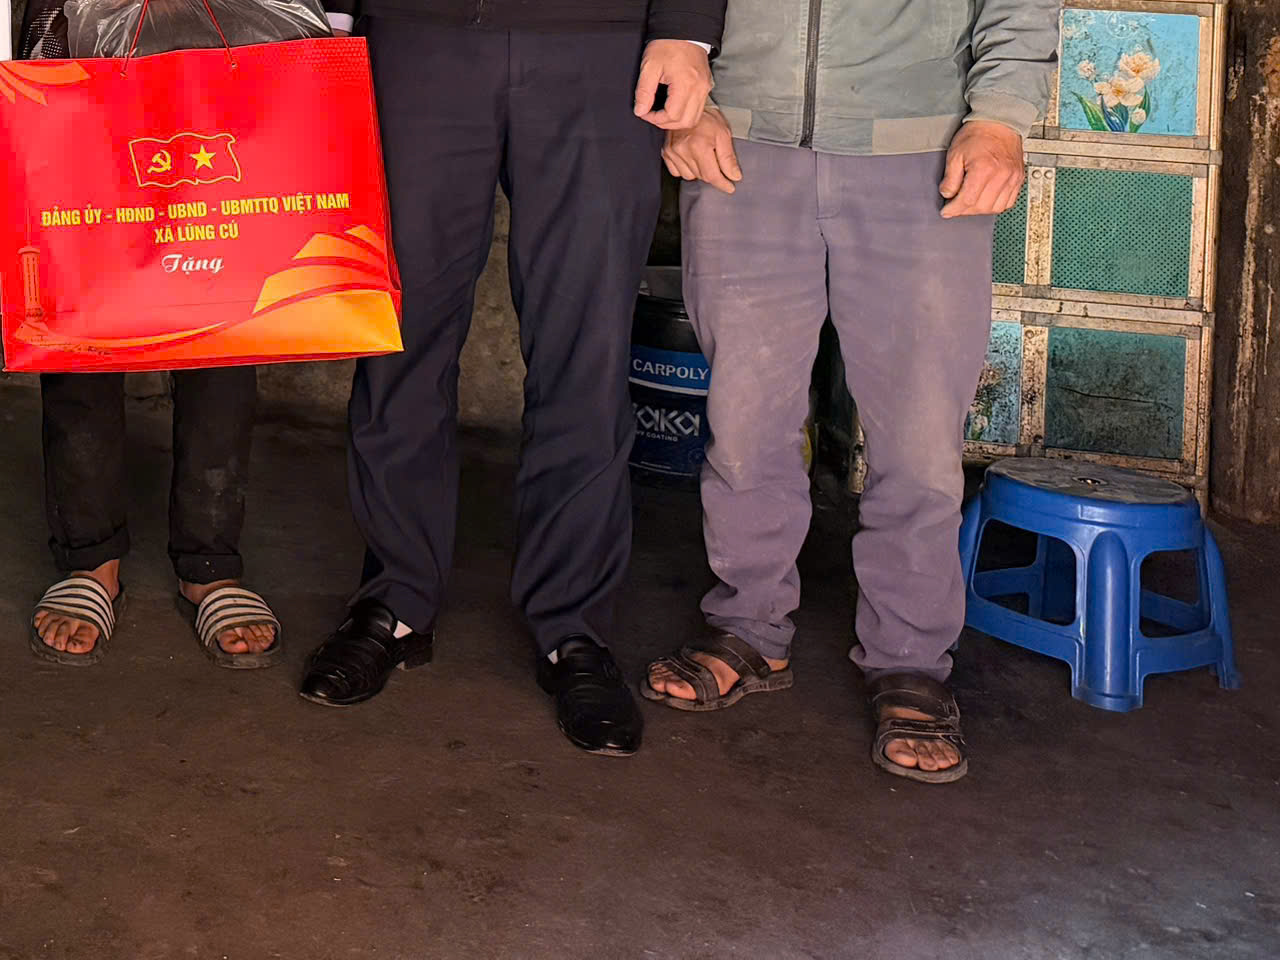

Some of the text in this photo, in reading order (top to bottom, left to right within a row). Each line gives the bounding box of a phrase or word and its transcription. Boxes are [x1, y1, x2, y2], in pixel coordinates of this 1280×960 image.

[41, 205, 81, 227] ĐẢNG
[84, 203, 103, 225] ỦY
[116, 207, 155, 223] HĐND
[168, 200, 208, 219] UBND
[220, 197, 280, 216] UBMTTQ
[282, 192, 313, 214] VIỆT
[316, 193, 350, 209] NAM
[155, 219, 240, 244] XÃ LŨNG CÚ
[161, 253, 225, 274] Tặng
[632, 357, 710, 381] CARPOLY
